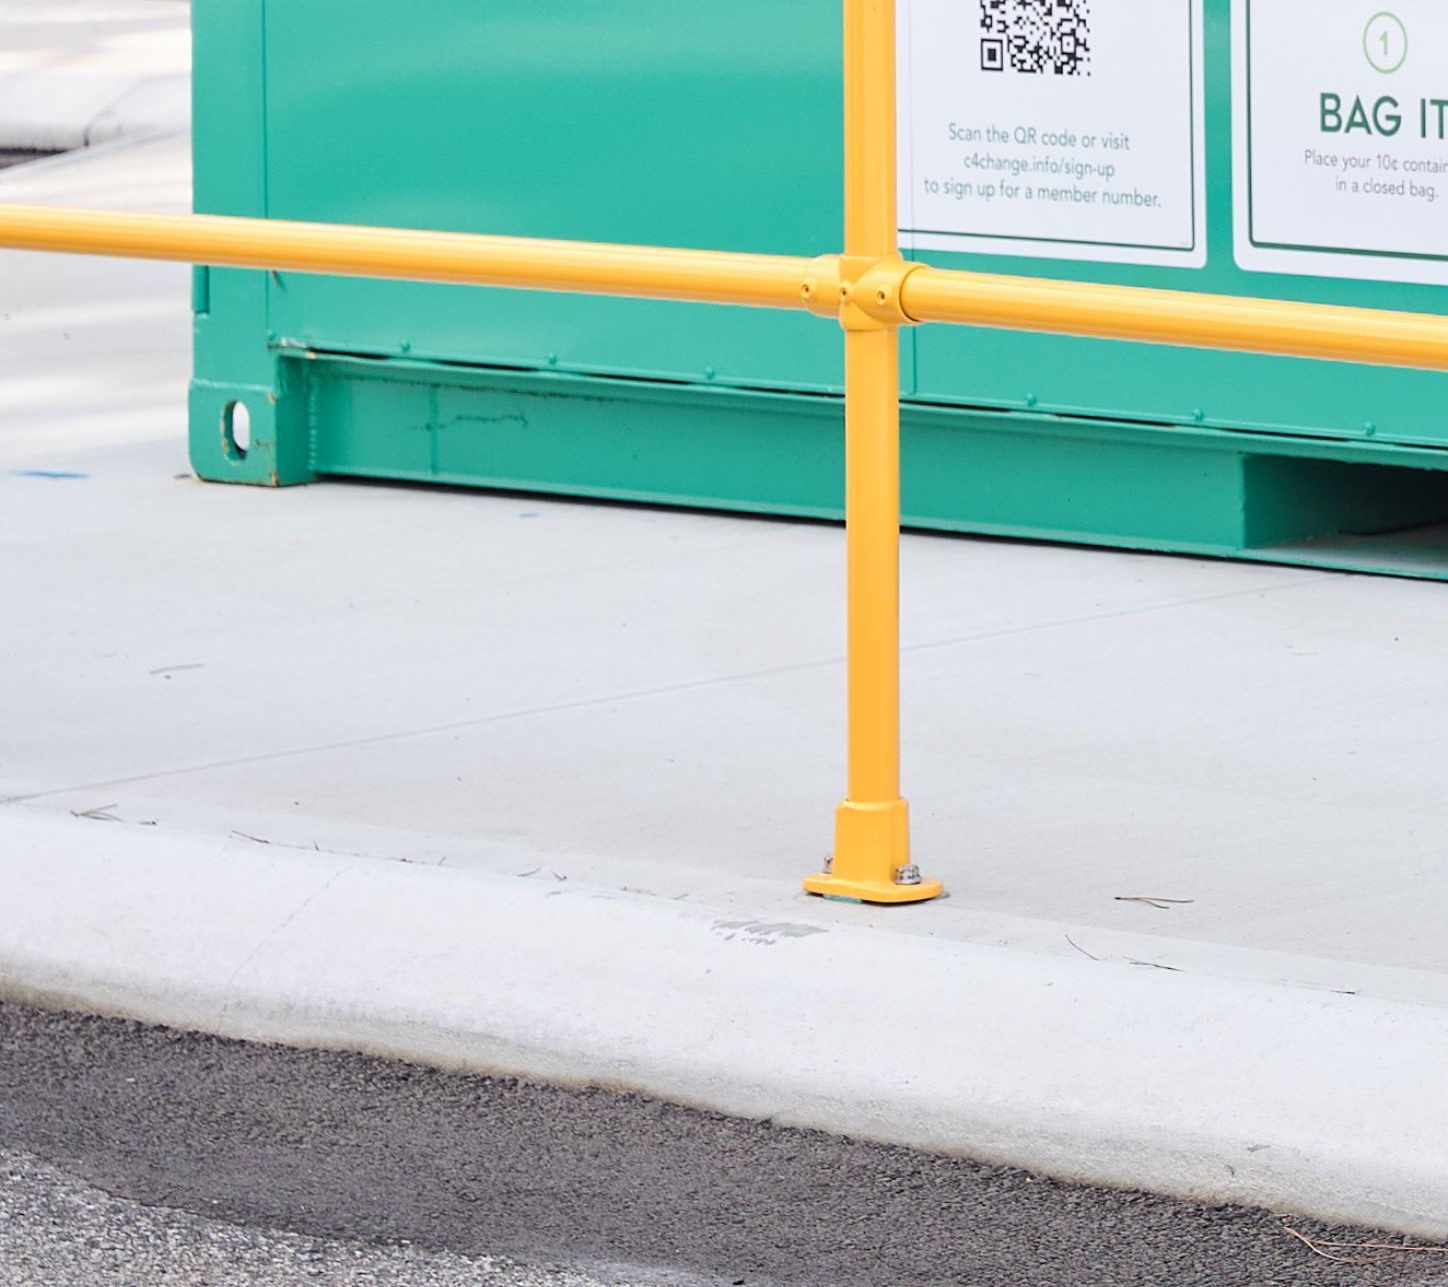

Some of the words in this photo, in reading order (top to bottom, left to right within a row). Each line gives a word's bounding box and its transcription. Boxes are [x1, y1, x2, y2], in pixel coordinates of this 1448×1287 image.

[1320, 93, 1401, 137] BAG
[949, 123, 981, 141] Scan
[986, 124, 1009, 143] the
[1014, 126, 1036, 144] QR
[1041, 129, 1077, 147] code
[1081, 135, 1096, 148] or
[1101, 132, 1130, 150] visit
[964, 153, 1115, 182] c4change.info/sign-up
[1305, 149, 1338, 167] Place
[1342, 157, 1371, 172] your
